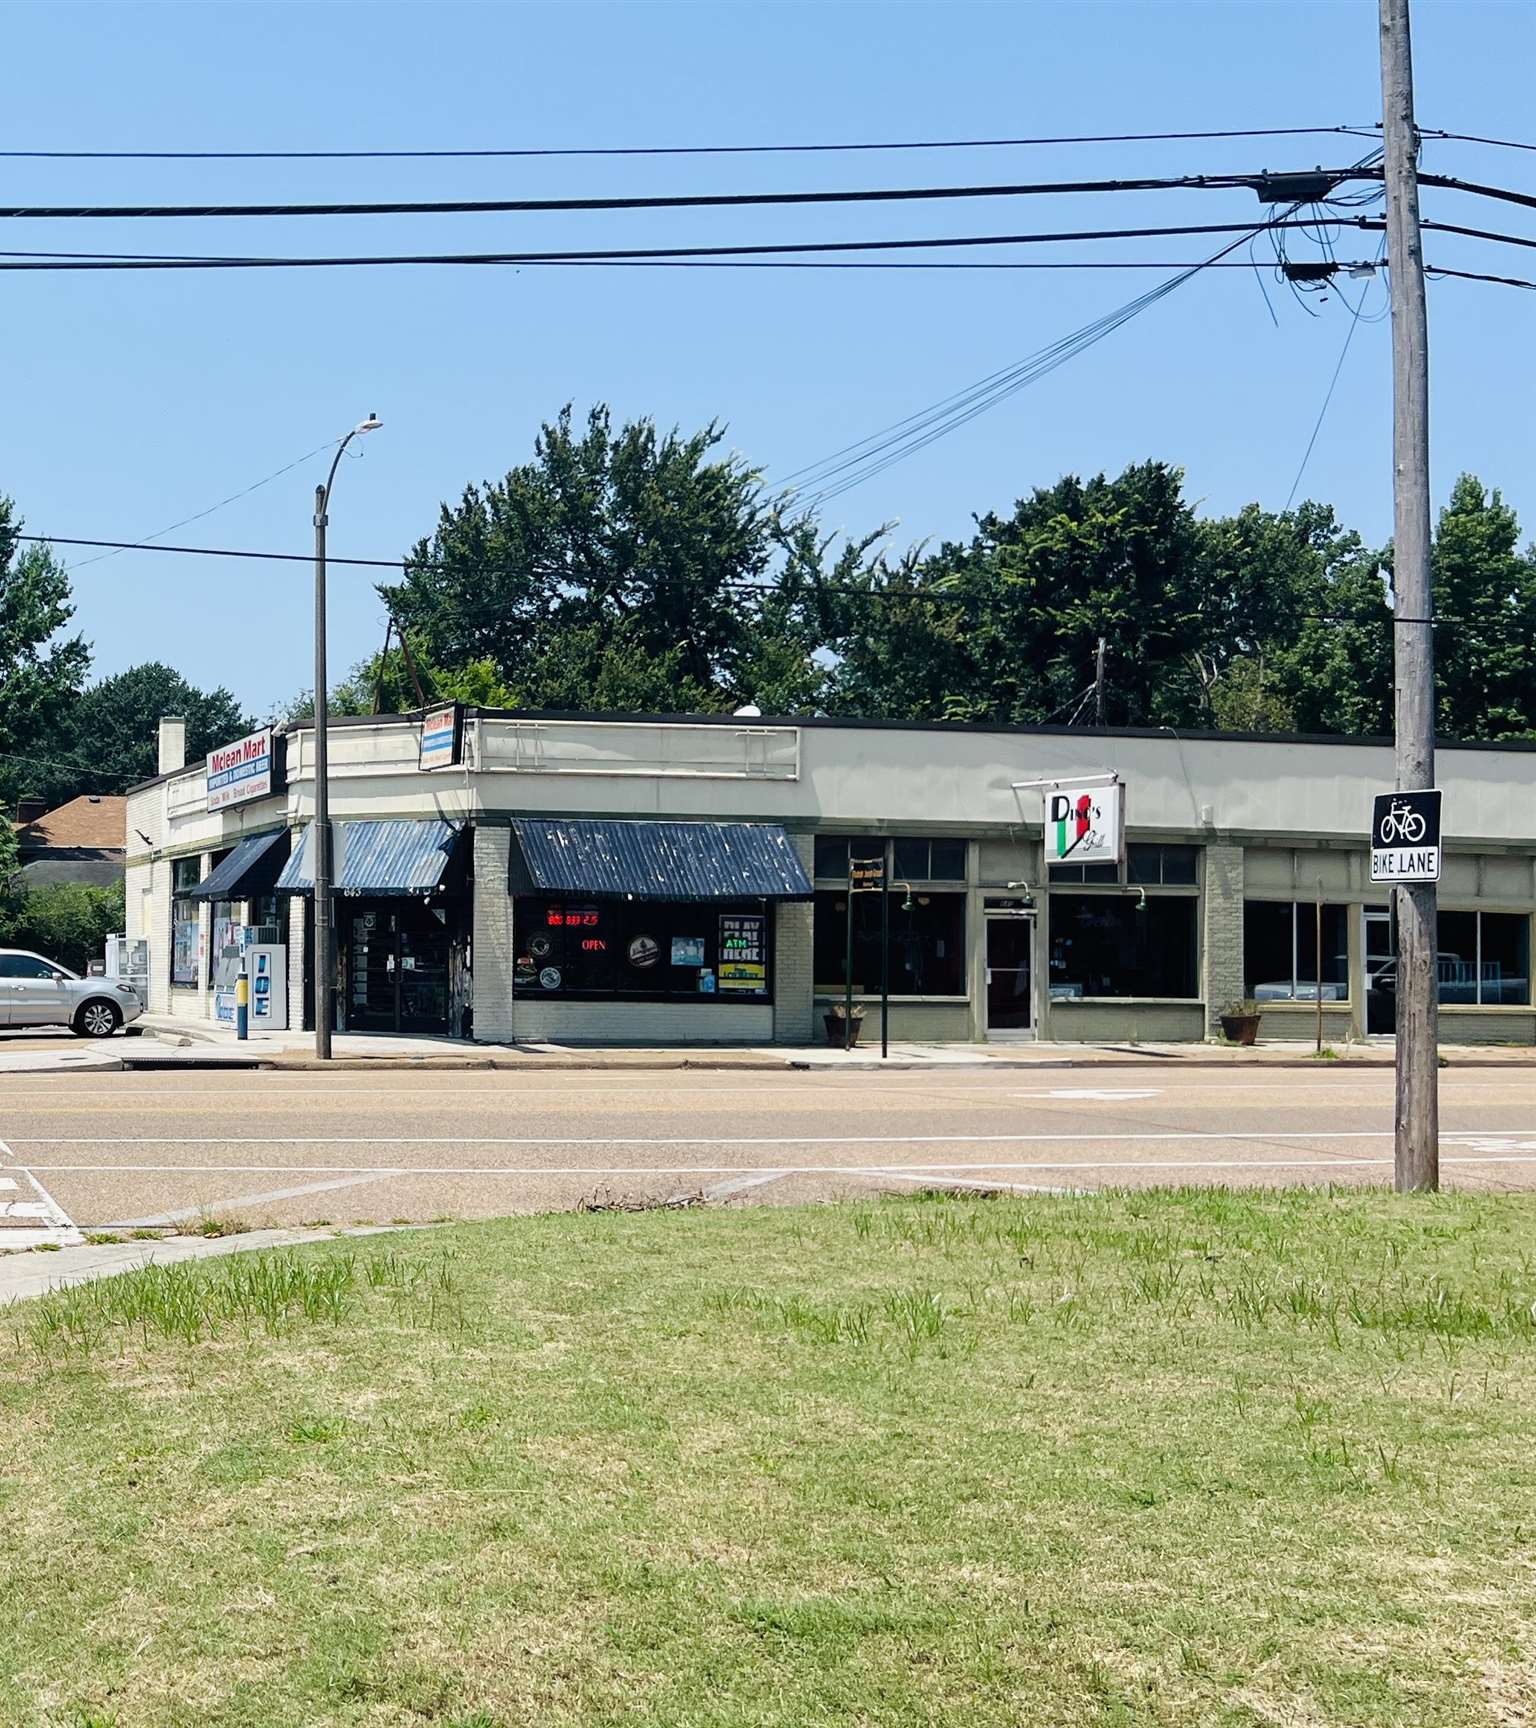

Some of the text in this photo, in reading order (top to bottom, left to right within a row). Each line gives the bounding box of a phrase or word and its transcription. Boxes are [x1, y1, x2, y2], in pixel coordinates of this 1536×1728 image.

[212, 736, 265, 774] Mclean Mart
[1373, 852, 1435, 874] BIKE LANE
[581, 940, 606, 951] OPEN
[725, 939, 747, 949] ATM
[255, 954, 269, 1016] ICE
